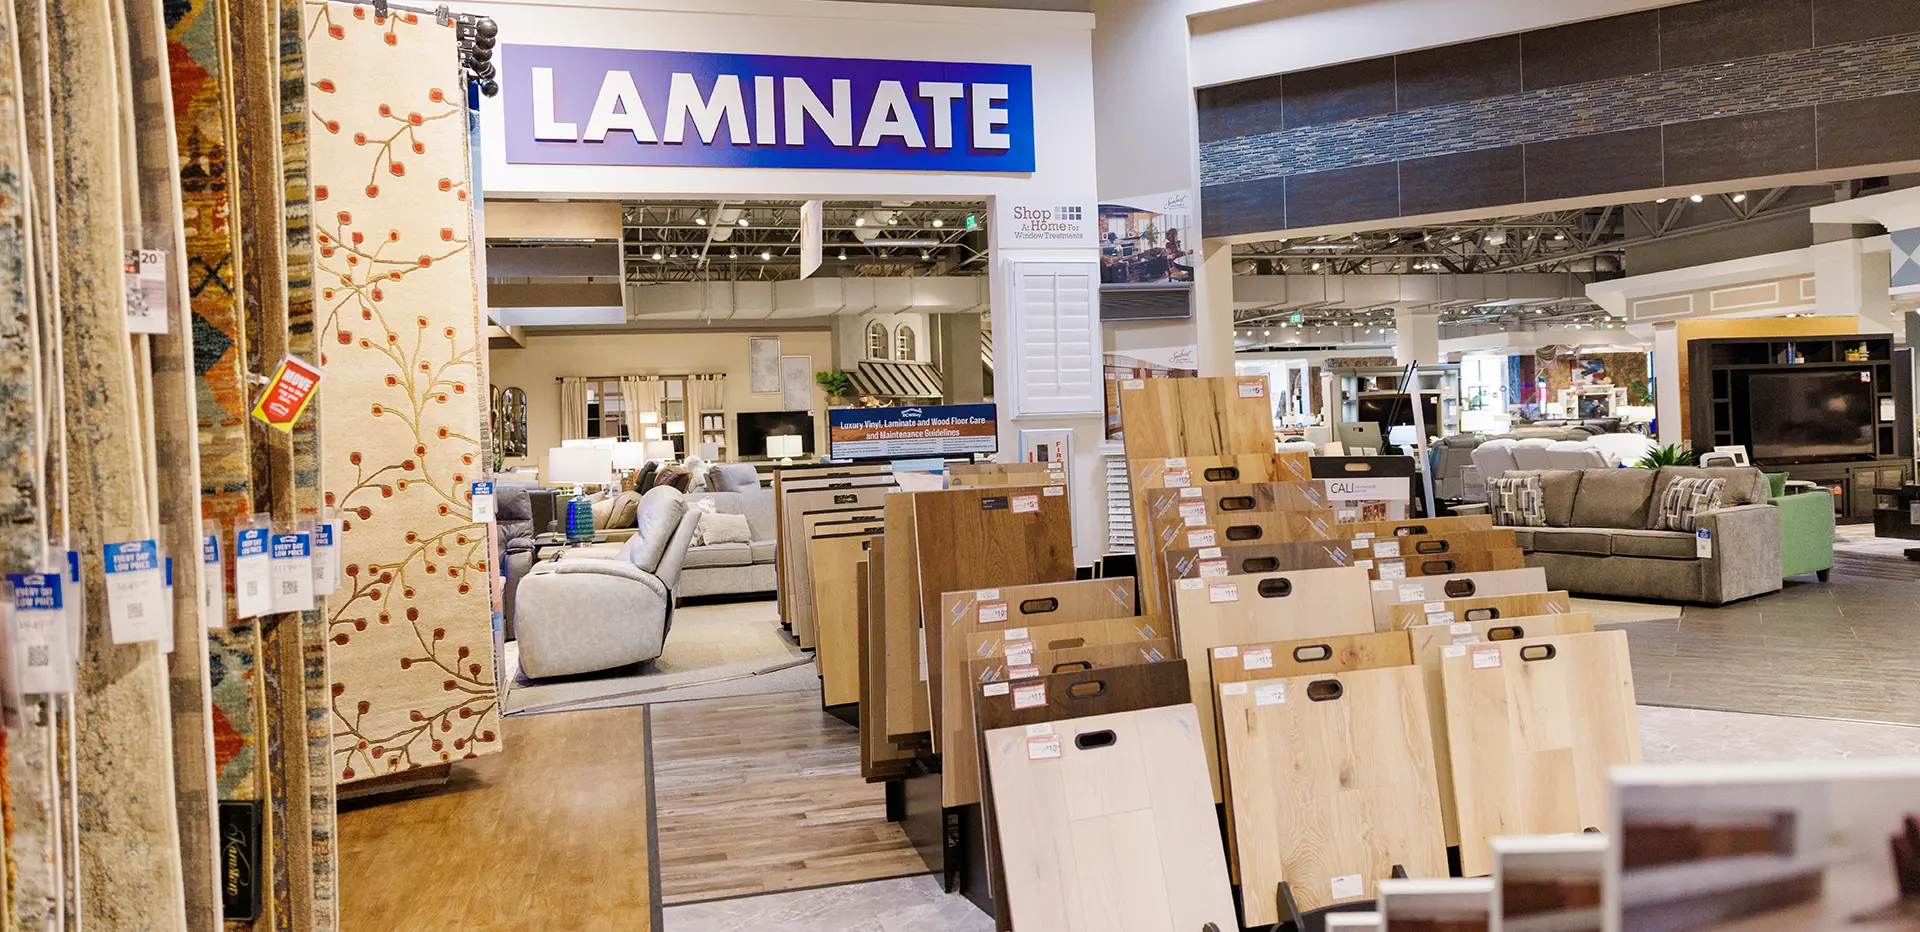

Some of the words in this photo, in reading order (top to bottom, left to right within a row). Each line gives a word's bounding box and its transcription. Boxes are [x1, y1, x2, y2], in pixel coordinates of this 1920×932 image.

[532, 67, 1010, 149] LAMINATE
[1014, 206, 1052, 223] Shop
[1031, 220, 1067, 231] Home
[1014, 231, 1044, 239] Window
[1044, 231, 1084, 239] Treatments
[281, 368, 314, 393] MOVE
[840, 421, 864, 430] Luxury
[864, 420, 882, 430] Vinyl,
[883, 418, 917, 428] Laminate
[917, 418, 930, 426] and
[931, 417, 950, 426] Wood
[950, 416, 969, 425] Floor
[969, 415, 986, 424] Care
[865, 431, 879, 440] and
[880, 429, 924, 439] Maintenance
[924, 428, 961, 438] Guidelines
[1330, 482, 1355, 494] CALI
